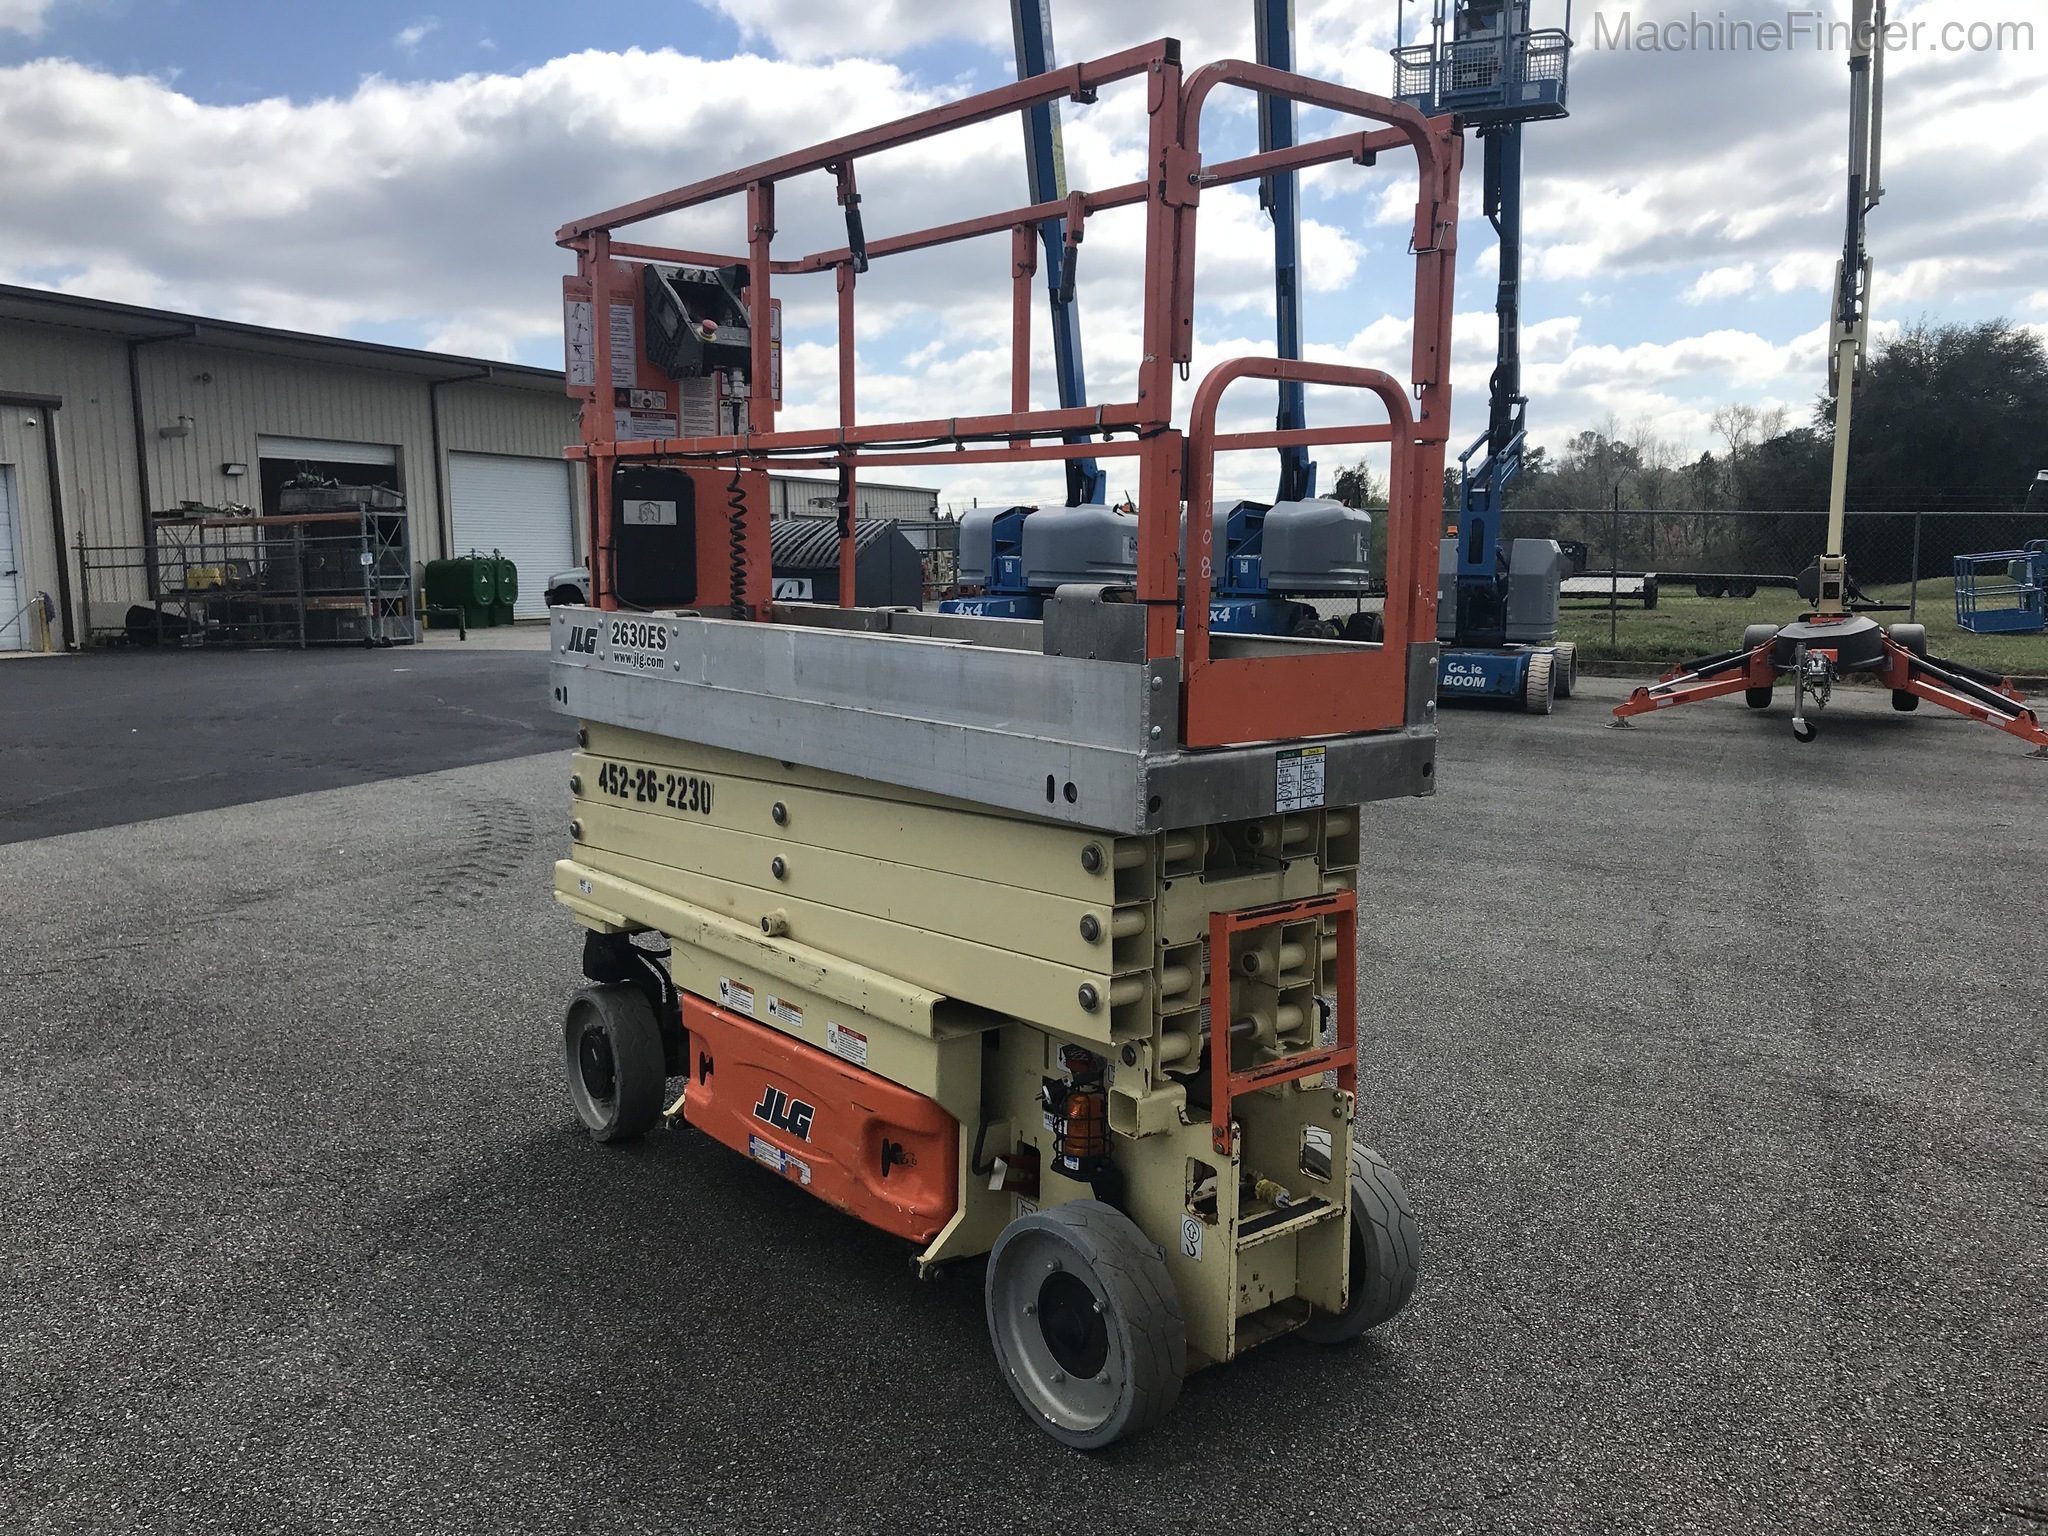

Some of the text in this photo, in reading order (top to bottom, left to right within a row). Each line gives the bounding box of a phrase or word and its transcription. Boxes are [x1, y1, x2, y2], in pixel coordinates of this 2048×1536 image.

[954, 602, 983, 616] 4x4
[1209, 607, 1231, 622] x4
[567, 625, 598, 655] JLG
[610, 621, 667, 651] 2630ES
[613, 652, 664, 669] www.jlg.com
[1447, 662, 1484, 675] Geie
[1442, 675, 1487, 688] BOOM
[598, 762, 712, 815] 452-26-2230
[753, 1084, 815, 1142] JLG
